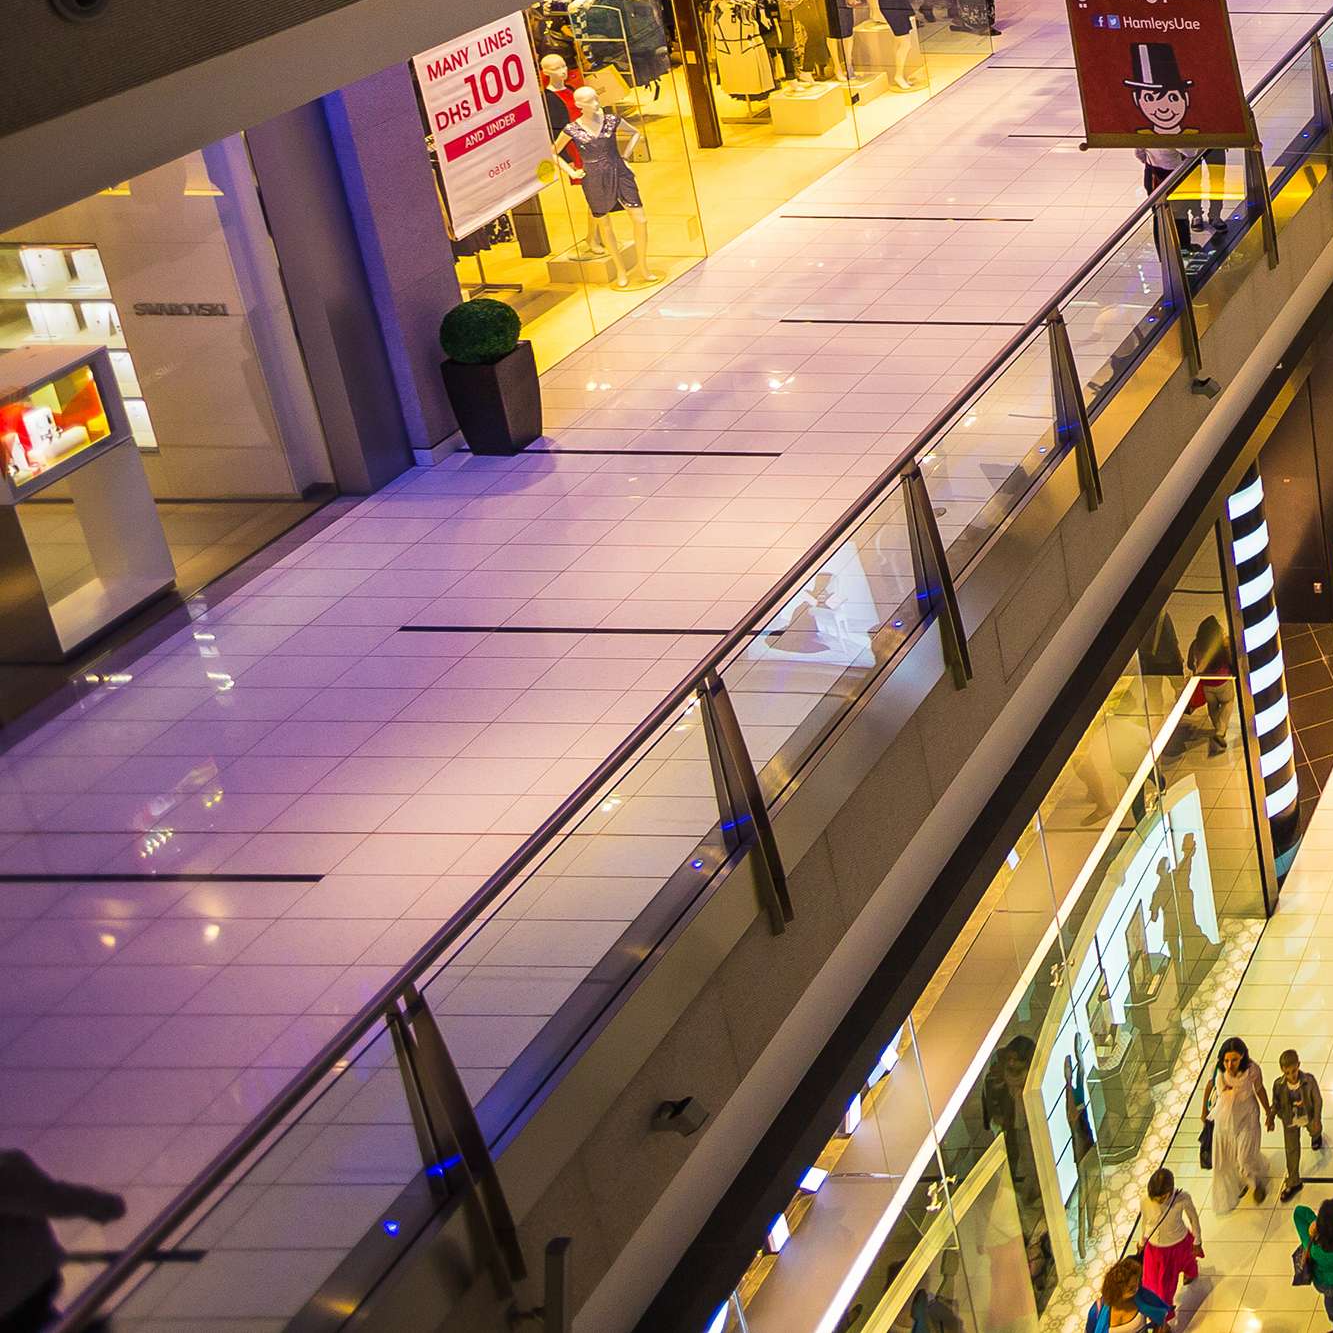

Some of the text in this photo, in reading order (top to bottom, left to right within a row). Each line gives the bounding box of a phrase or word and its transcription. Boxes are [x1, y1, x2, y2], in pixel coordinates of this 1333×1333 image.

[1123, 16, 1200, 32] HamleysUae
[426, 27, 513, 82] MANY LINES
[435, 53, 525, 132] DHS 100
[465, 114, 516, 149] AND UNDER
[489, 159, 512, 178] oasis
